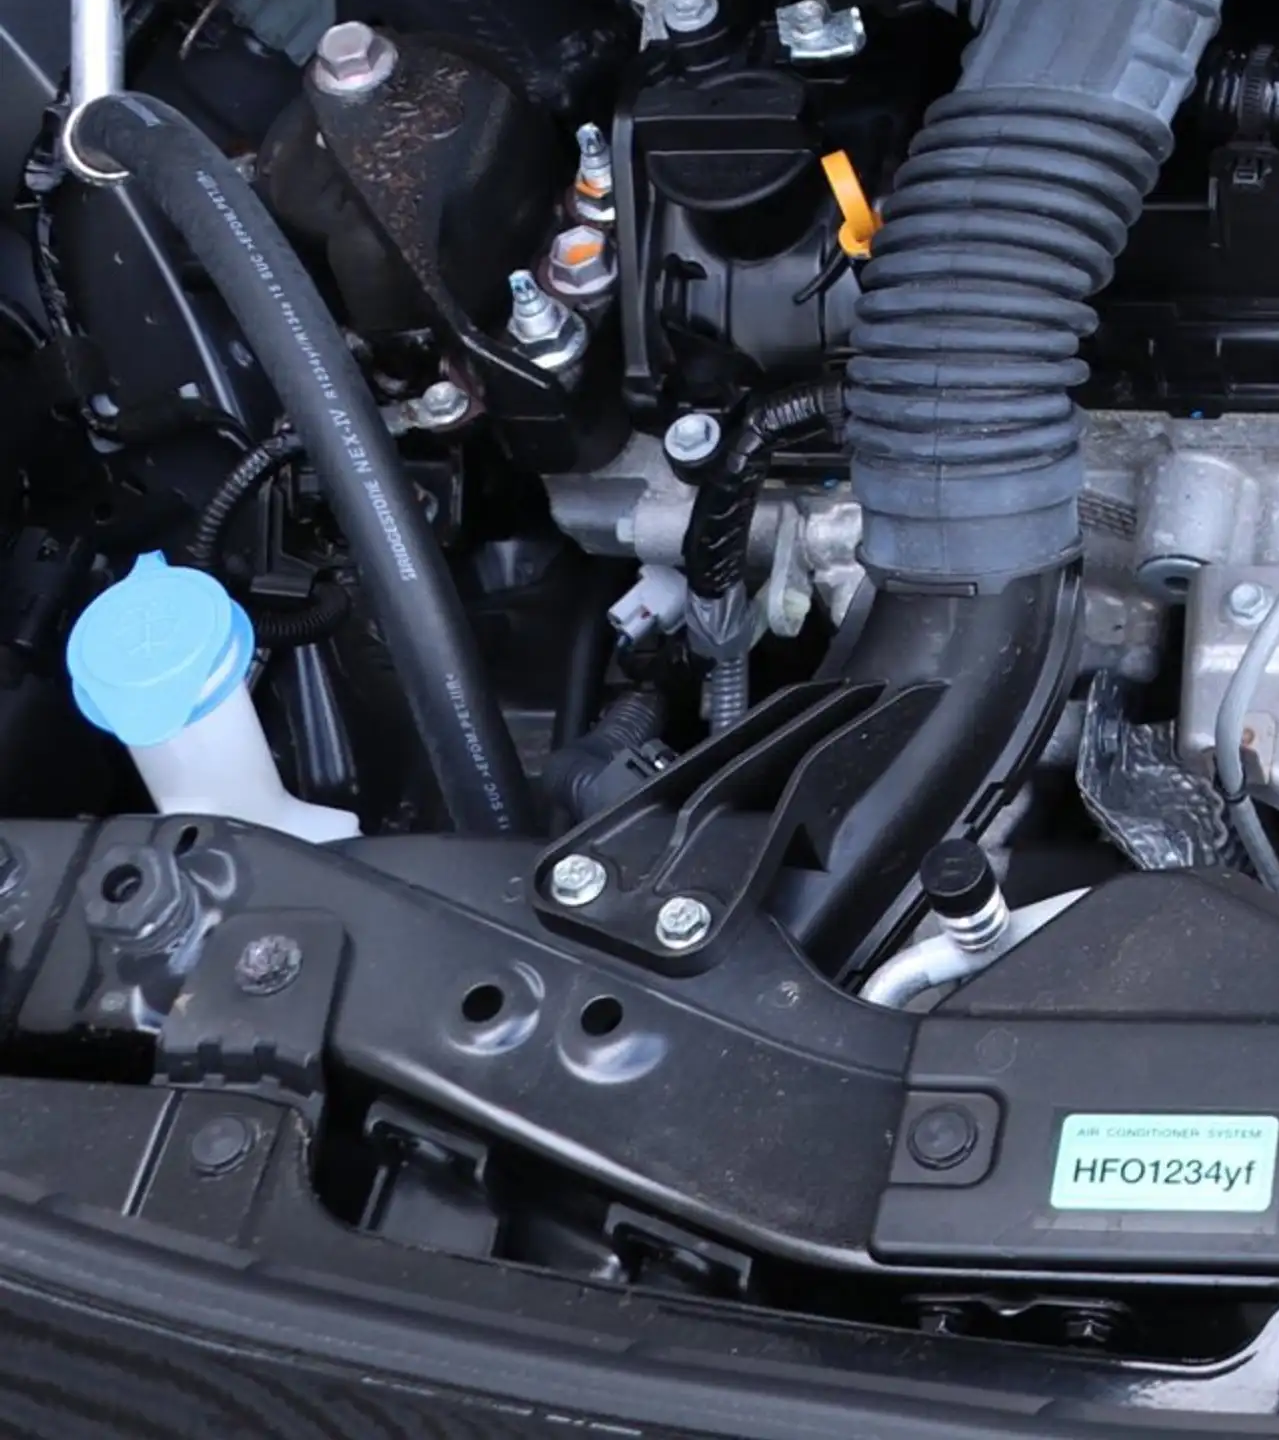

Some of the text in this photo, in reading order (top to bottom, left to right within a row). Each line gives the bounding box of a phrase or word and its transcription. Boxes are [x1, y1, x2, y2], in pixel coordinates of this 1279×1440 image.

[328, 409, 372, 474] NEX-IV
[363, 479, 417, 581] BRIDGESTONE
[483, 781, 504, 811] SUC
[1076, 1126, 1263, 1140] AIR CONDITIONER SYSTEM
[1072, 1157, 1257, 1193] HFO1234yf
